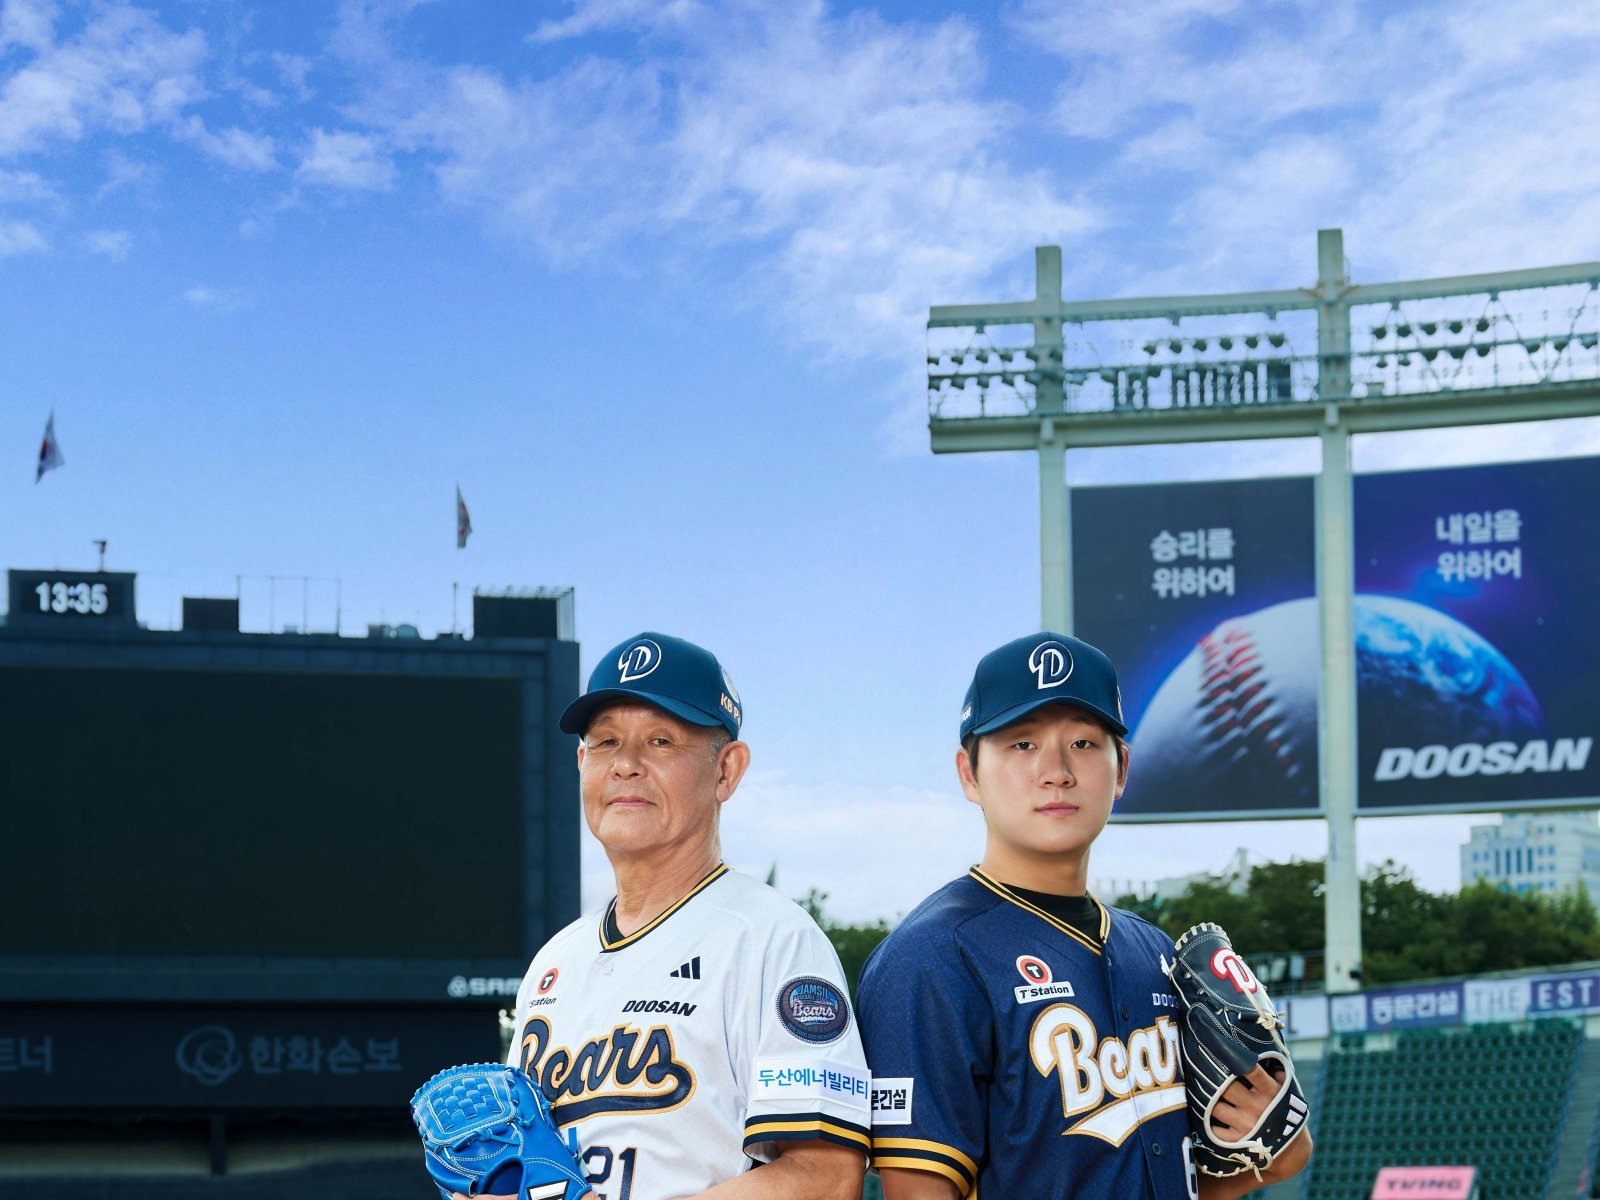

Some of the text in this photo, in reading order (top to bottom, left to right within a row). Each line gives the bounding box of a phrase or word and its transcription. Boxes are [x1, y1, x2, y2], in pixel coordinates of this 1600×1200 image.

[1436, 509, 1523, 544] 내일을
[1150, 528, 1236, 562] 승리를
[1152, 565, 1235, 598] 위하여
[1436, 547, 1521, 582] 위하여
[35, 581, 108, 614] 13:35
[1373, 737, 1593, 782] DOOSAN
[622, 1000, 697, 1016] DOOSAN
[1537, 978, 1593, 1010] EST
[249, 1036, 402, 1074] 한화손보
[520, 1015, 697, 1118] Bears
[1029, 1002, 1185, 1118] Bear
[758, 1068, 868, 1099] 두산에너빌리티
